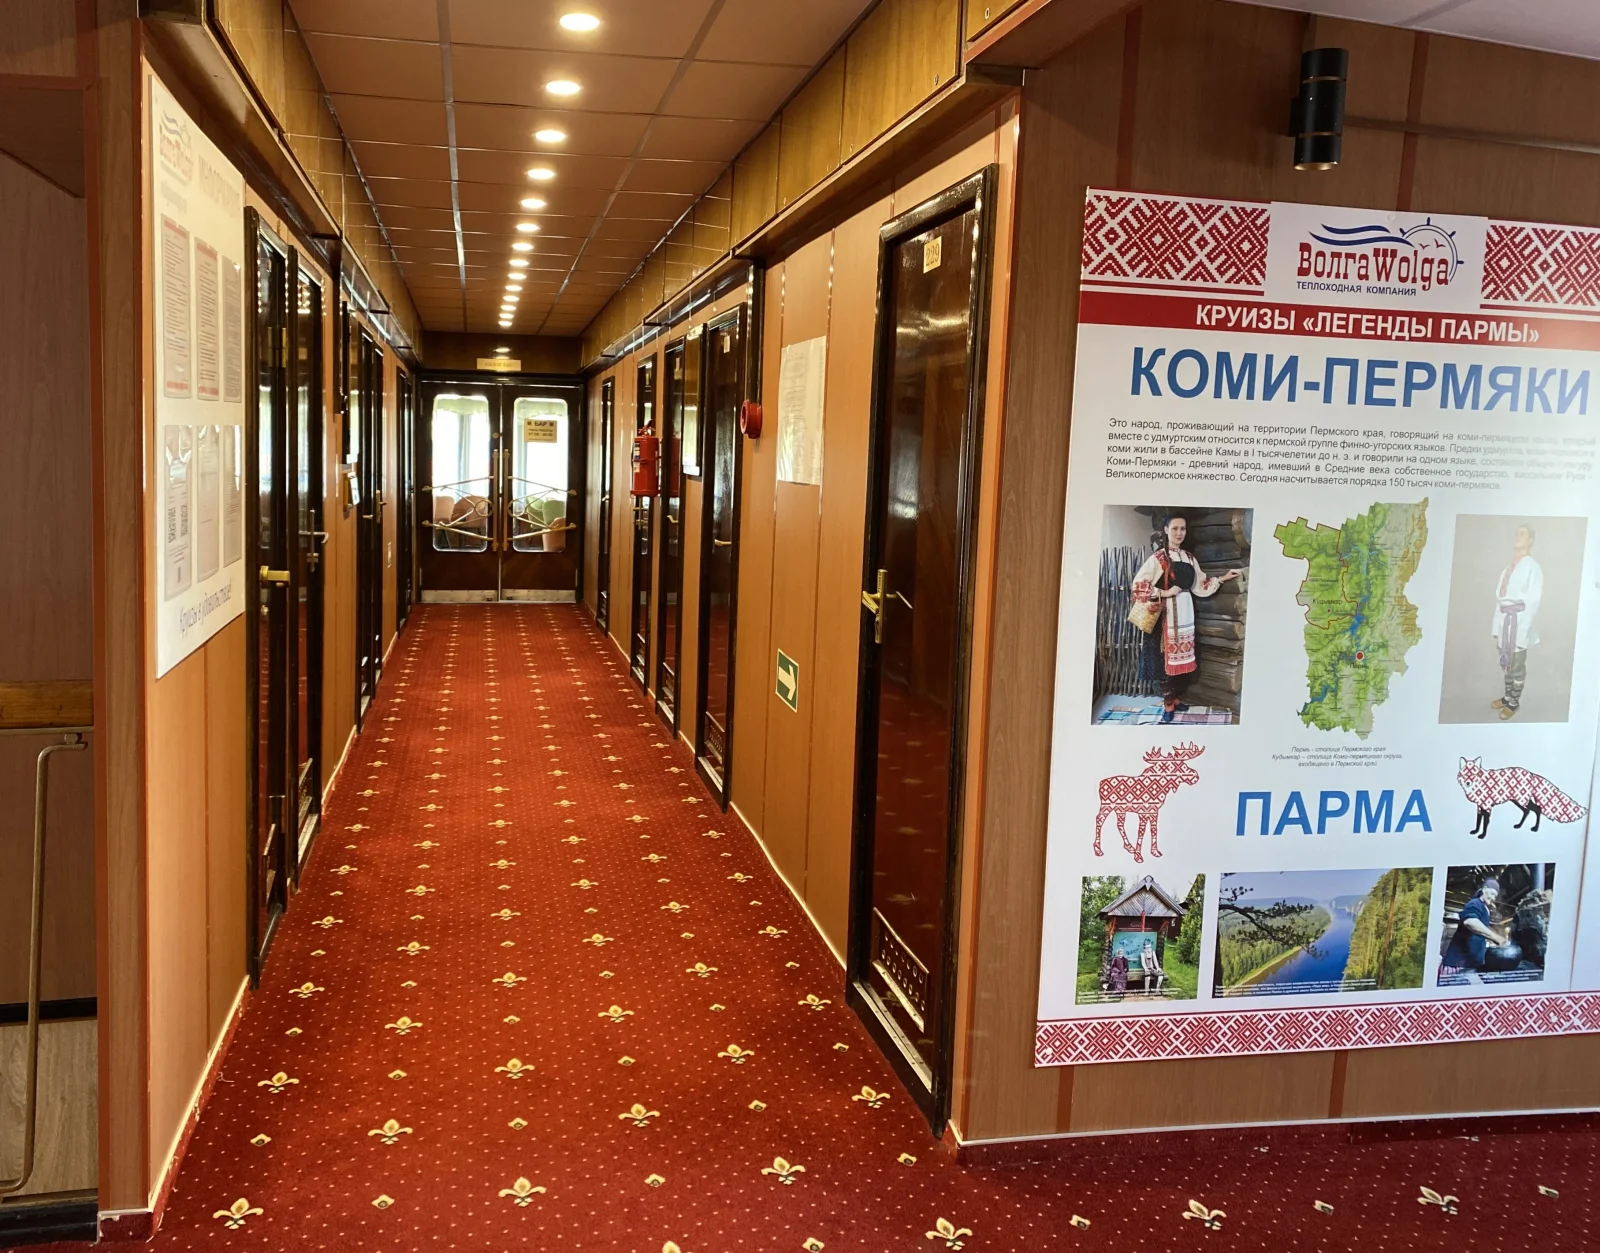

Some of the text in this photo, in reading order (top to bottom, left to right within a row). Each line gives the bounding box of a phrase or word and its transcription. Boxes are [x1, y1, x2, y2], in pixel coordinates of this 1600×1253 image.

[1296, 281, 1417, 297] ТЕПЛОХОДНАЯ КОМПАНИЯ
[1196, 304, 1539, 343] КРУИЗЫ «ЛЕГЕНДЫ ПАРМЫ»
[1130, 347, 1591, 416] КОМИ-ПЕРМЯКИ
[1109, 418, 1127, 428] Это
[1132, 420, 1162, 430] народ,
[1167, 422, 1234, 432] проживающий
[1254, 425, 1306, 434] территории
[1311, 426, 1358, 437] Пермского
[1363, 429, 1385, 438] края,
[1390, 430, 1439, 440] говорящий
[1109, 432, 1142, 441] вместе
[1151, 433, 1205, 444] удмуртским
[1208, 436, 1254, 445] относится
[1257, 437, 1261, 445] к
[1263, 437, 1306, 447] пермской
[1308, 440, 1338, 449] группе
[1340, 440, 1411, 452] финно-угорских
[1414, 444, 1447, 452] языков.
[1450, 444, 1481, 454] Предки
[1108, 445, 1130, 453] коми
[1133, 446, 1158, 454] жили
[1169, 445, 1213, 456] бассейне
[1216, 447, 1241, 457] Камы
[1244, 449, 1249, 457] в
[1258, 449, 1316, 459] тысячелетии
[1318, 452, 1330, 461] до
[1362, 454, 1403, 464] говорили
[1420, 456, 1447, 464] одном
[1107, 456, 1176, 468] Коми-Пермяки
[1189, 460, 1228, 469] древний
[1233, 462, 1263, 471] народ,
[1269, 463, 1310, 471] имевший
[1325, 463, 1365, 474] Средние
[1370, 466, 1390, 474] века
[1395, 466, 1451, 476] собственное
[1106, 469, 1185, 480] Великопермское
[1187, 472, 1237, 481] княжество.
[1240, 472, 1278, 484] Сегодня
[1280, 476, 1348, 485] насчитывается
[1350, 478, 1387, 487] порядка
[1389, 478, 1405, 487] 150
[1407, 480, 1433, 488] тысяч
[1236, 789, 1432, 836] ПАРМА
